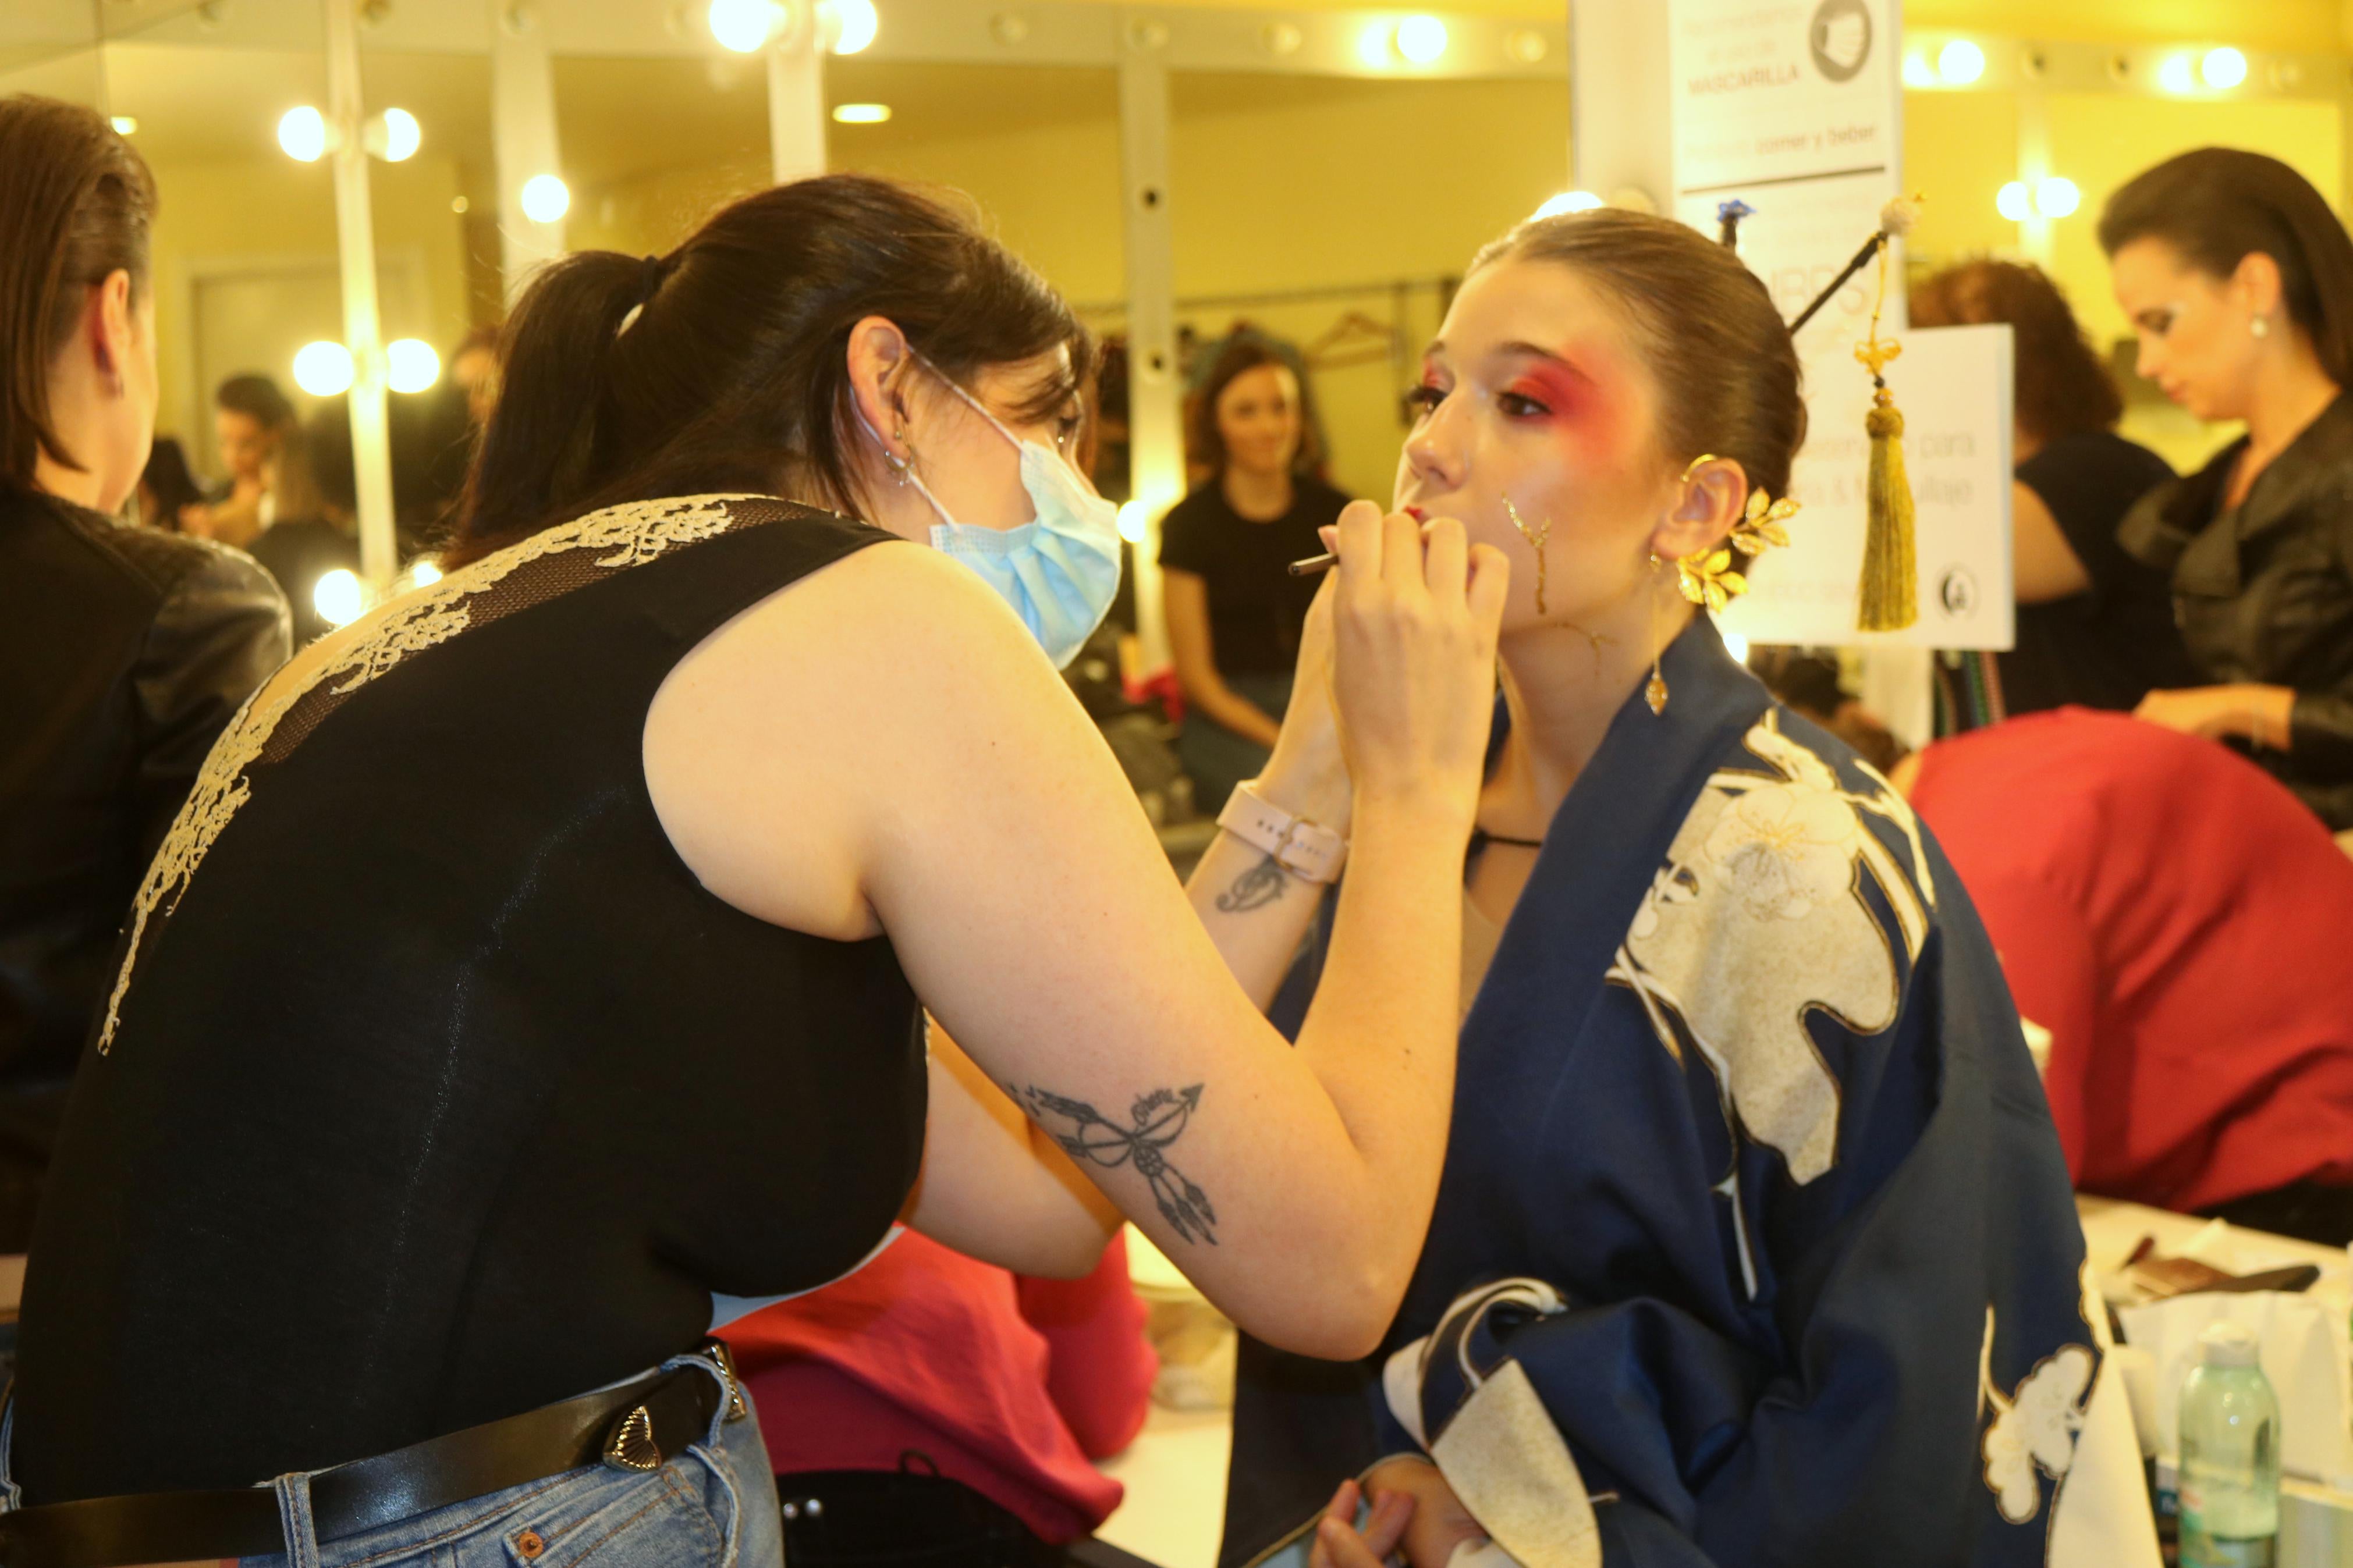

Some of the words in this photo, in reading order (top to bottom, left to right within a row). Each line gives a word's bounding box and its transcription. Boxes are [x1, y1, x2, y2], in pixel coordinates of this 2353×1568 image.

[1687, 64, 1800, 97] MASCARILLA
[1755, 133, 1808, 156] comer
[1827, 122, 1878, 146] beber
